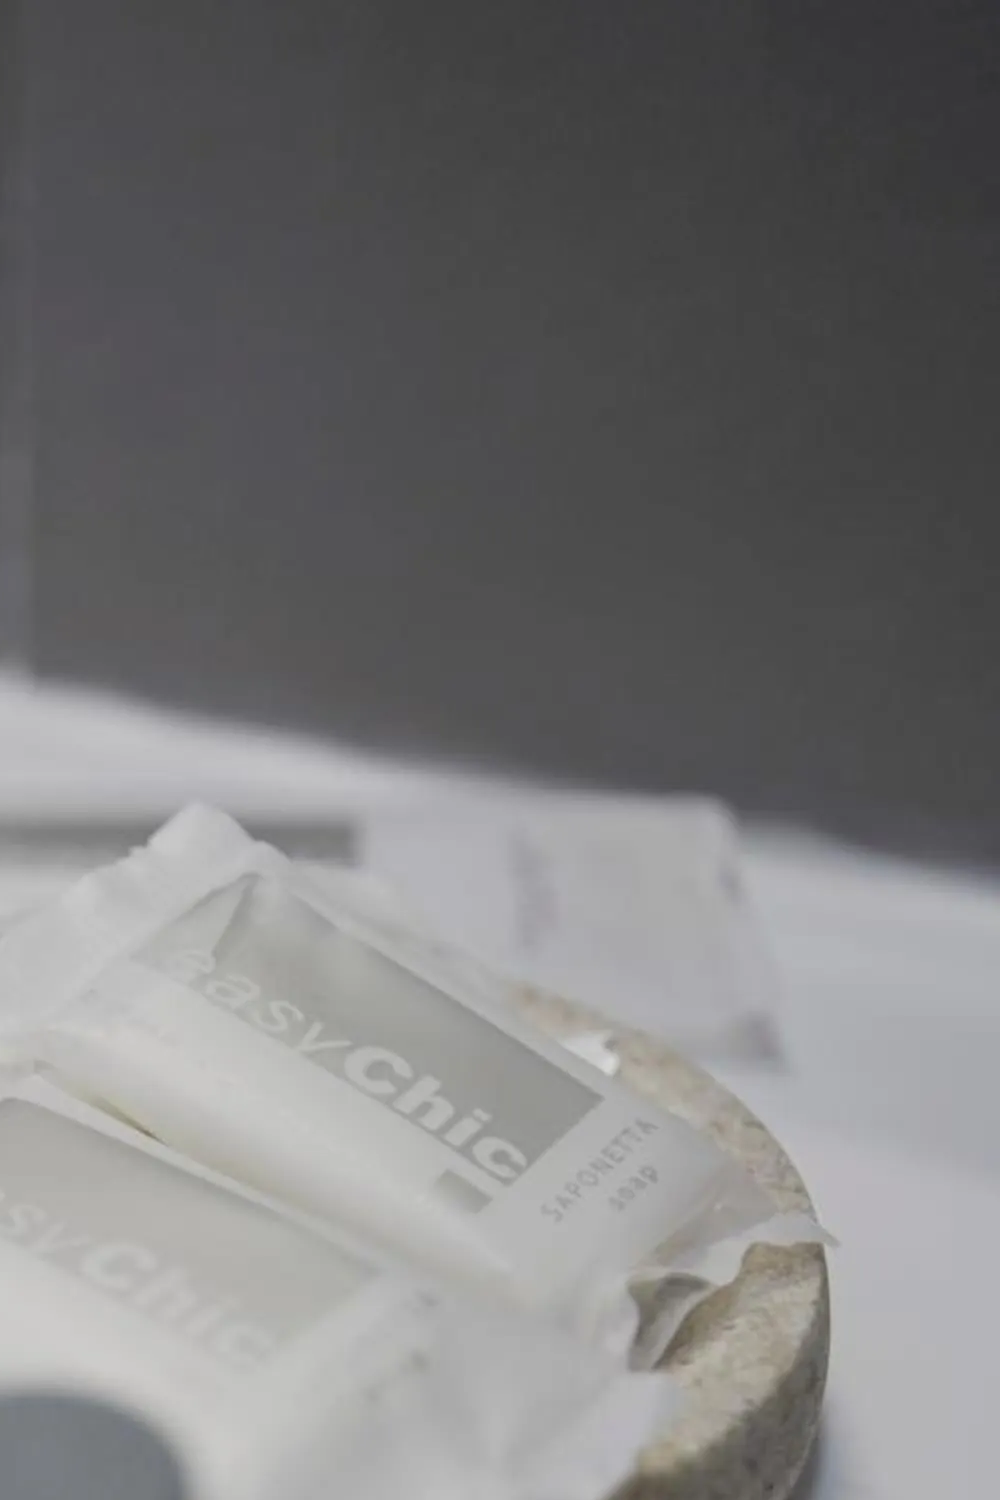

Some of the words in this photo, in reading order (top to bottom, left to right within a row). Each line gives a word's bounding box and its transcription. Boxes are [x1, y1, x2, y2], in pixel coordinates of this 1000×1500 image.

[163, 948, 530, 1181] easyChic
[540, 1117, 660, 1223] SAPONETTA
[607, 1165, 659, 1212] soap
